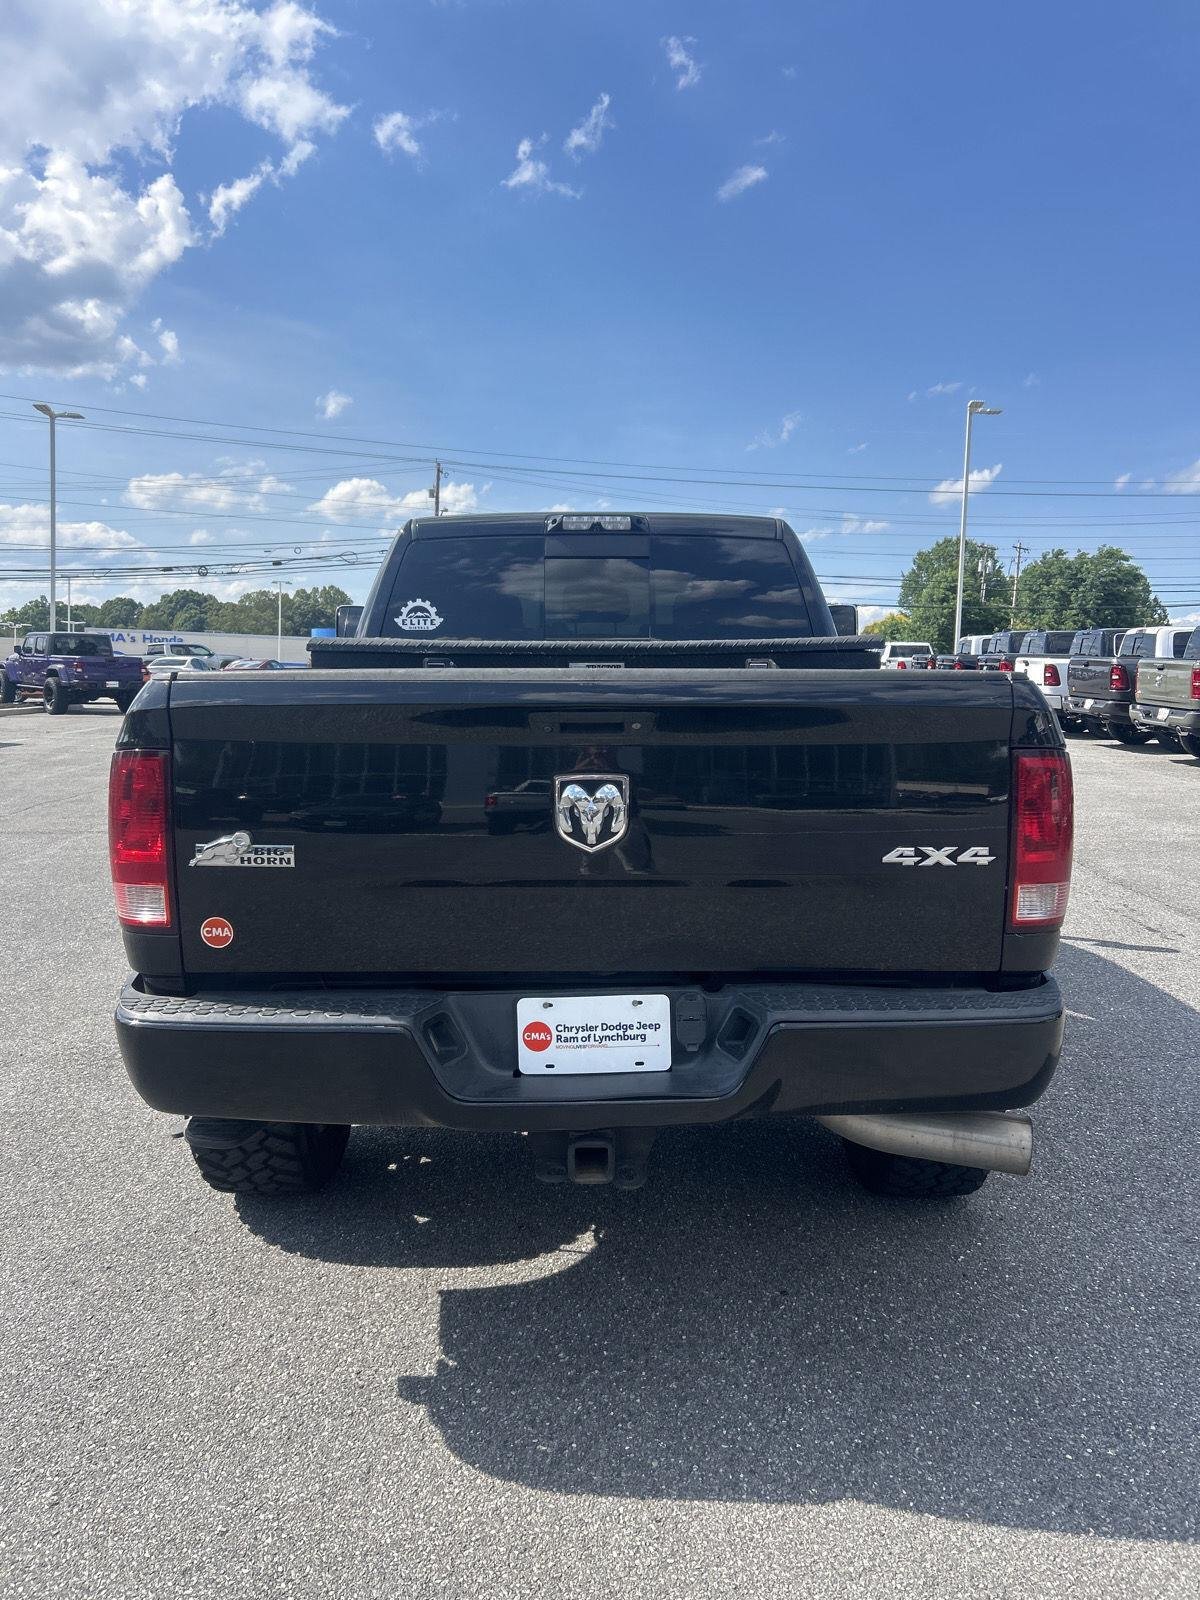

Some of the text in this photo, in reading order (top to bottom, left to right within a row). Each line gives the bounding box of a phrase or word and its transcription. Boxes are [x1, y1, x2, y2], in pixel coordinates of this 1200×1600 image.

[401, 618, 436, 626] ELITE
[142, 634, 184, 643] Honda
[253, 847, 285, 856] BIG
[882, 846, 997, 866] 4X4
[240, 857, 292, 865] HORN
[203, 927, 232, 937] CMA
[555, 1021, 661, 1035] Chrysler Dodge Jeep
[524, 1032, 552, 1041] CMA's
[555, 1031, 647, 1044] Ram of Lynchburg
